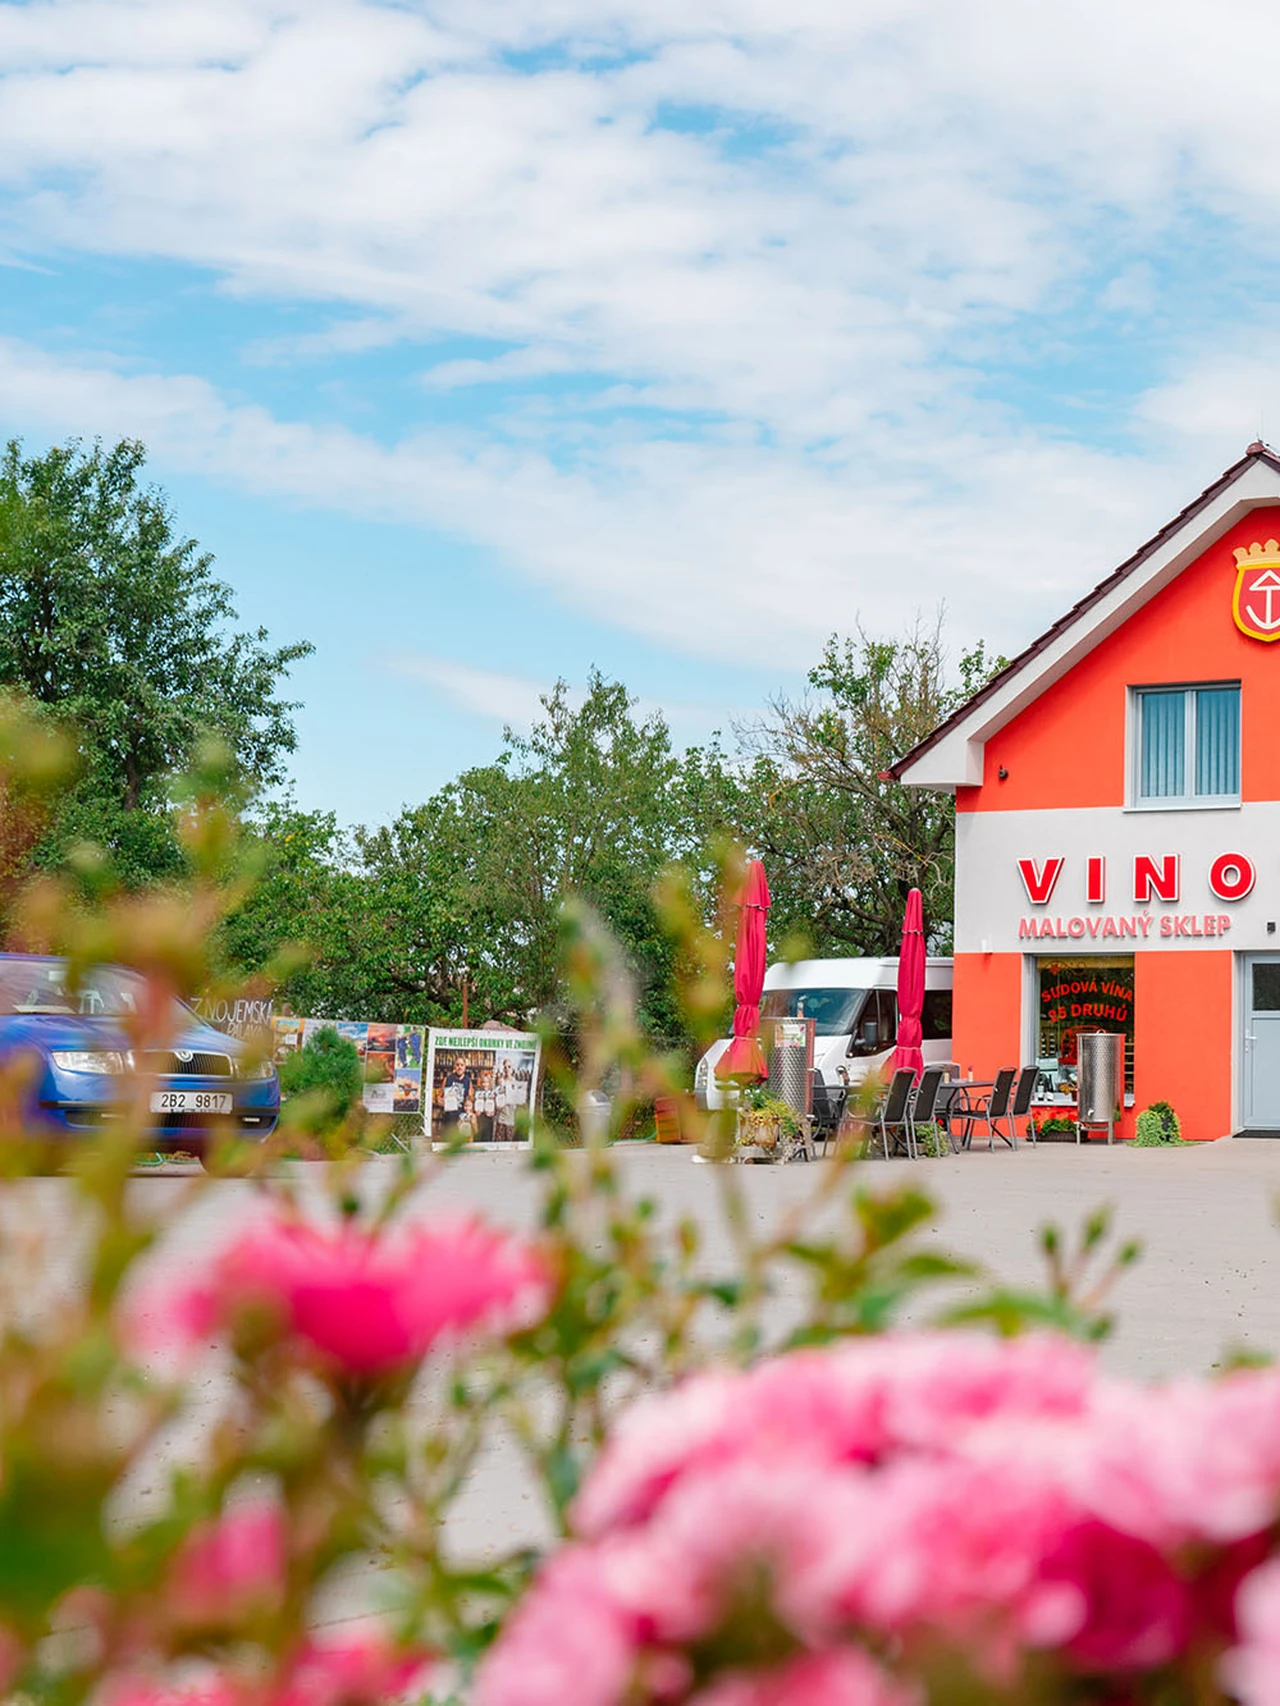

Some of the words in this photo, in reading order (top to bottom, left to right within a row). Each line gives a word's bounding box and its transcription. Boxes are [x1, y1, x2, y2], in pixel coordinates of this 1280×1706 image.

[1018, 909, 1153, 938] MALOVANÝ
[1160, 914, 1231, 938] SKLEP
[1041, 977, 1098, 1003] SUDOVÁ
[1101, 979, 1133, 1002] VÍNA
[1071, 1003, 1128, 1022] DRUHŮ
[161, 1094, 186, 1107] 2B2
[195, 1094, 227, 1108] 9817
